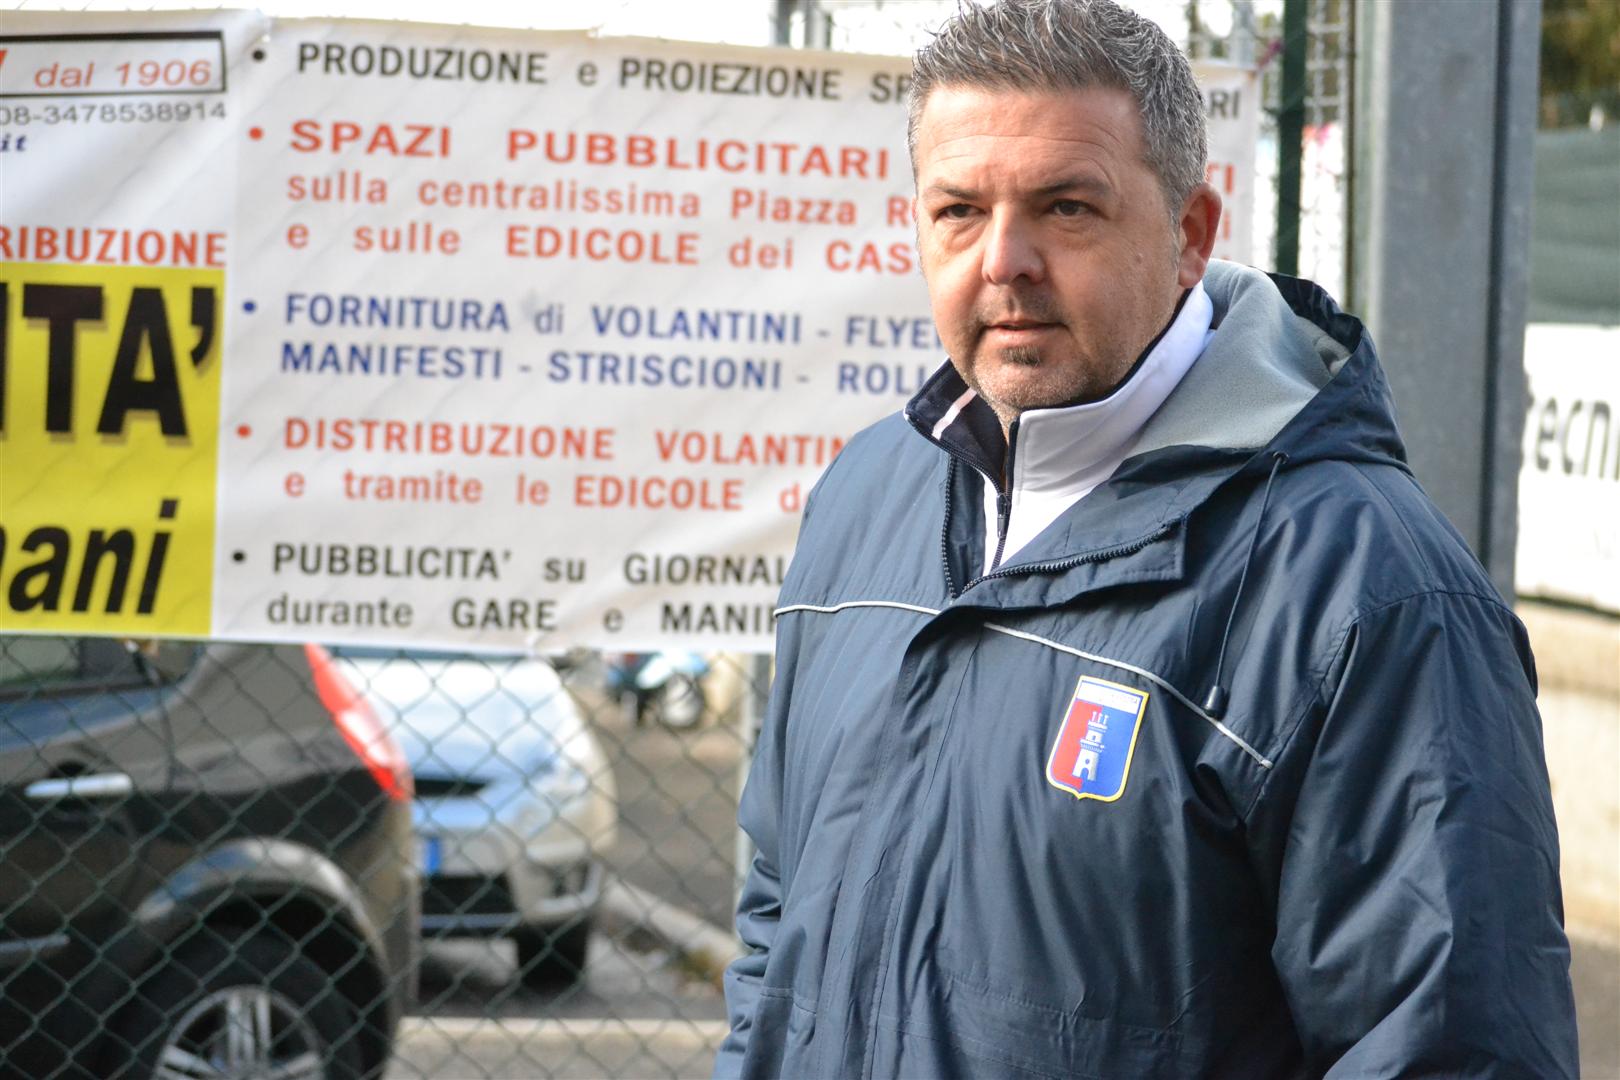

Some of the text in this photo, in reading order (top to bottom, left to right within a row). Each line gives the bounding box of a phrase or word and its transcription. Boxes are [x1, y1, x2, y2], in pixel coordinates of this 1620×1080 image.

[34, 59, 212, 88] dal 1906
[299, 43, 547, 84] PRODUZIONE
[577, 62, 597, 86] e
[620, 58, 841, 100] PROIEZIONE
[290, 120, 451, 158] SPAZI
[507, 129, 889, 180] PUBBLICITARI
[287, 170, 388, 203] sulla
[419, 180, 700, 219] centralissima
[731, 187, 857, 227] Piazza
[287, 221, 912, 275] e sulle EDICOLE dei CAS
[286, 294, 509, 333] FORNITURA
[535, 304, 563, 333] di
[592, 305, 801, 344] VOLANTINI
[0, 282, 216, 440] TA'
[282, 343, 501, 380] MANIFESTI
[548, 351, 782, 389] STRISCIONI
[285, 418, 615, 460] DISTRIBUZIONE
[285, 474, 304, 496] e
[344, 470, 482, 504] tramite
[517, 473, 548, 505] le
[574, 476, 744, 511] EDICOLE
[0, 498, 180, 616] ani
[273, 543, 511, 582] PUBBLICITA'
[544, 557, 585, 583] su
[267, 593, 413, 628] durante
[451, 597, 557, 632] GARE
[604, 609, 623, 633] e
